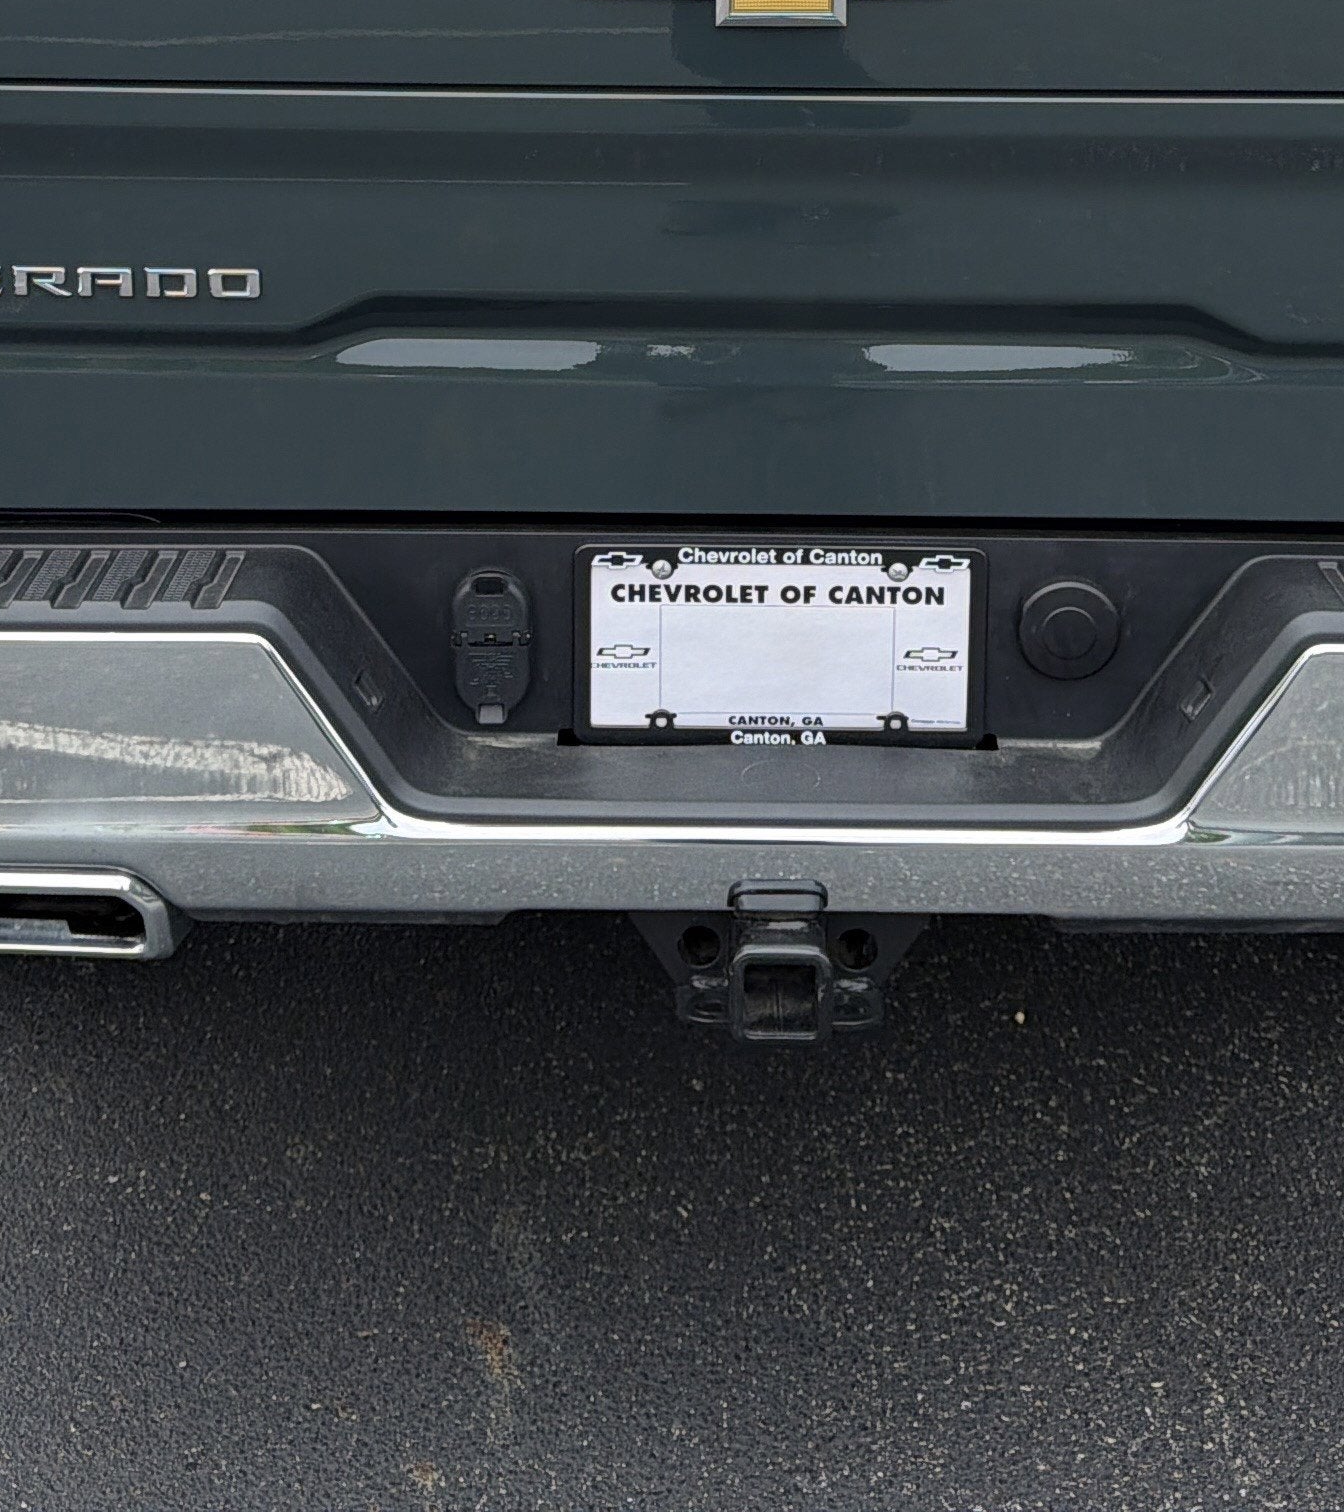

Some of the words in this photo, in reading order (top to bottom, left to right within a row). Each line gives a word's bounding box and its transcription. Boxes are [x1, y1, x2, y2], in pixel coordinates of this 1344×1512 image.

[677, 547, 777, 564] Chevrolet
[783, 547, 803, 564] of
[809, 548, 882, 565] Canton
[610, 583, 769, 604] CHEVROLET
[780, 585, 817, 605] OF
[828, 586, 946, 606] CANTON
[896, 664, 964, 672] CHEVROLET
[728, 715, 796, 728] CANTON,
[802, 715, 824, 727] GA
[730, 731, 796, 746] Canton,
[801, 732, 826, 746] GA
